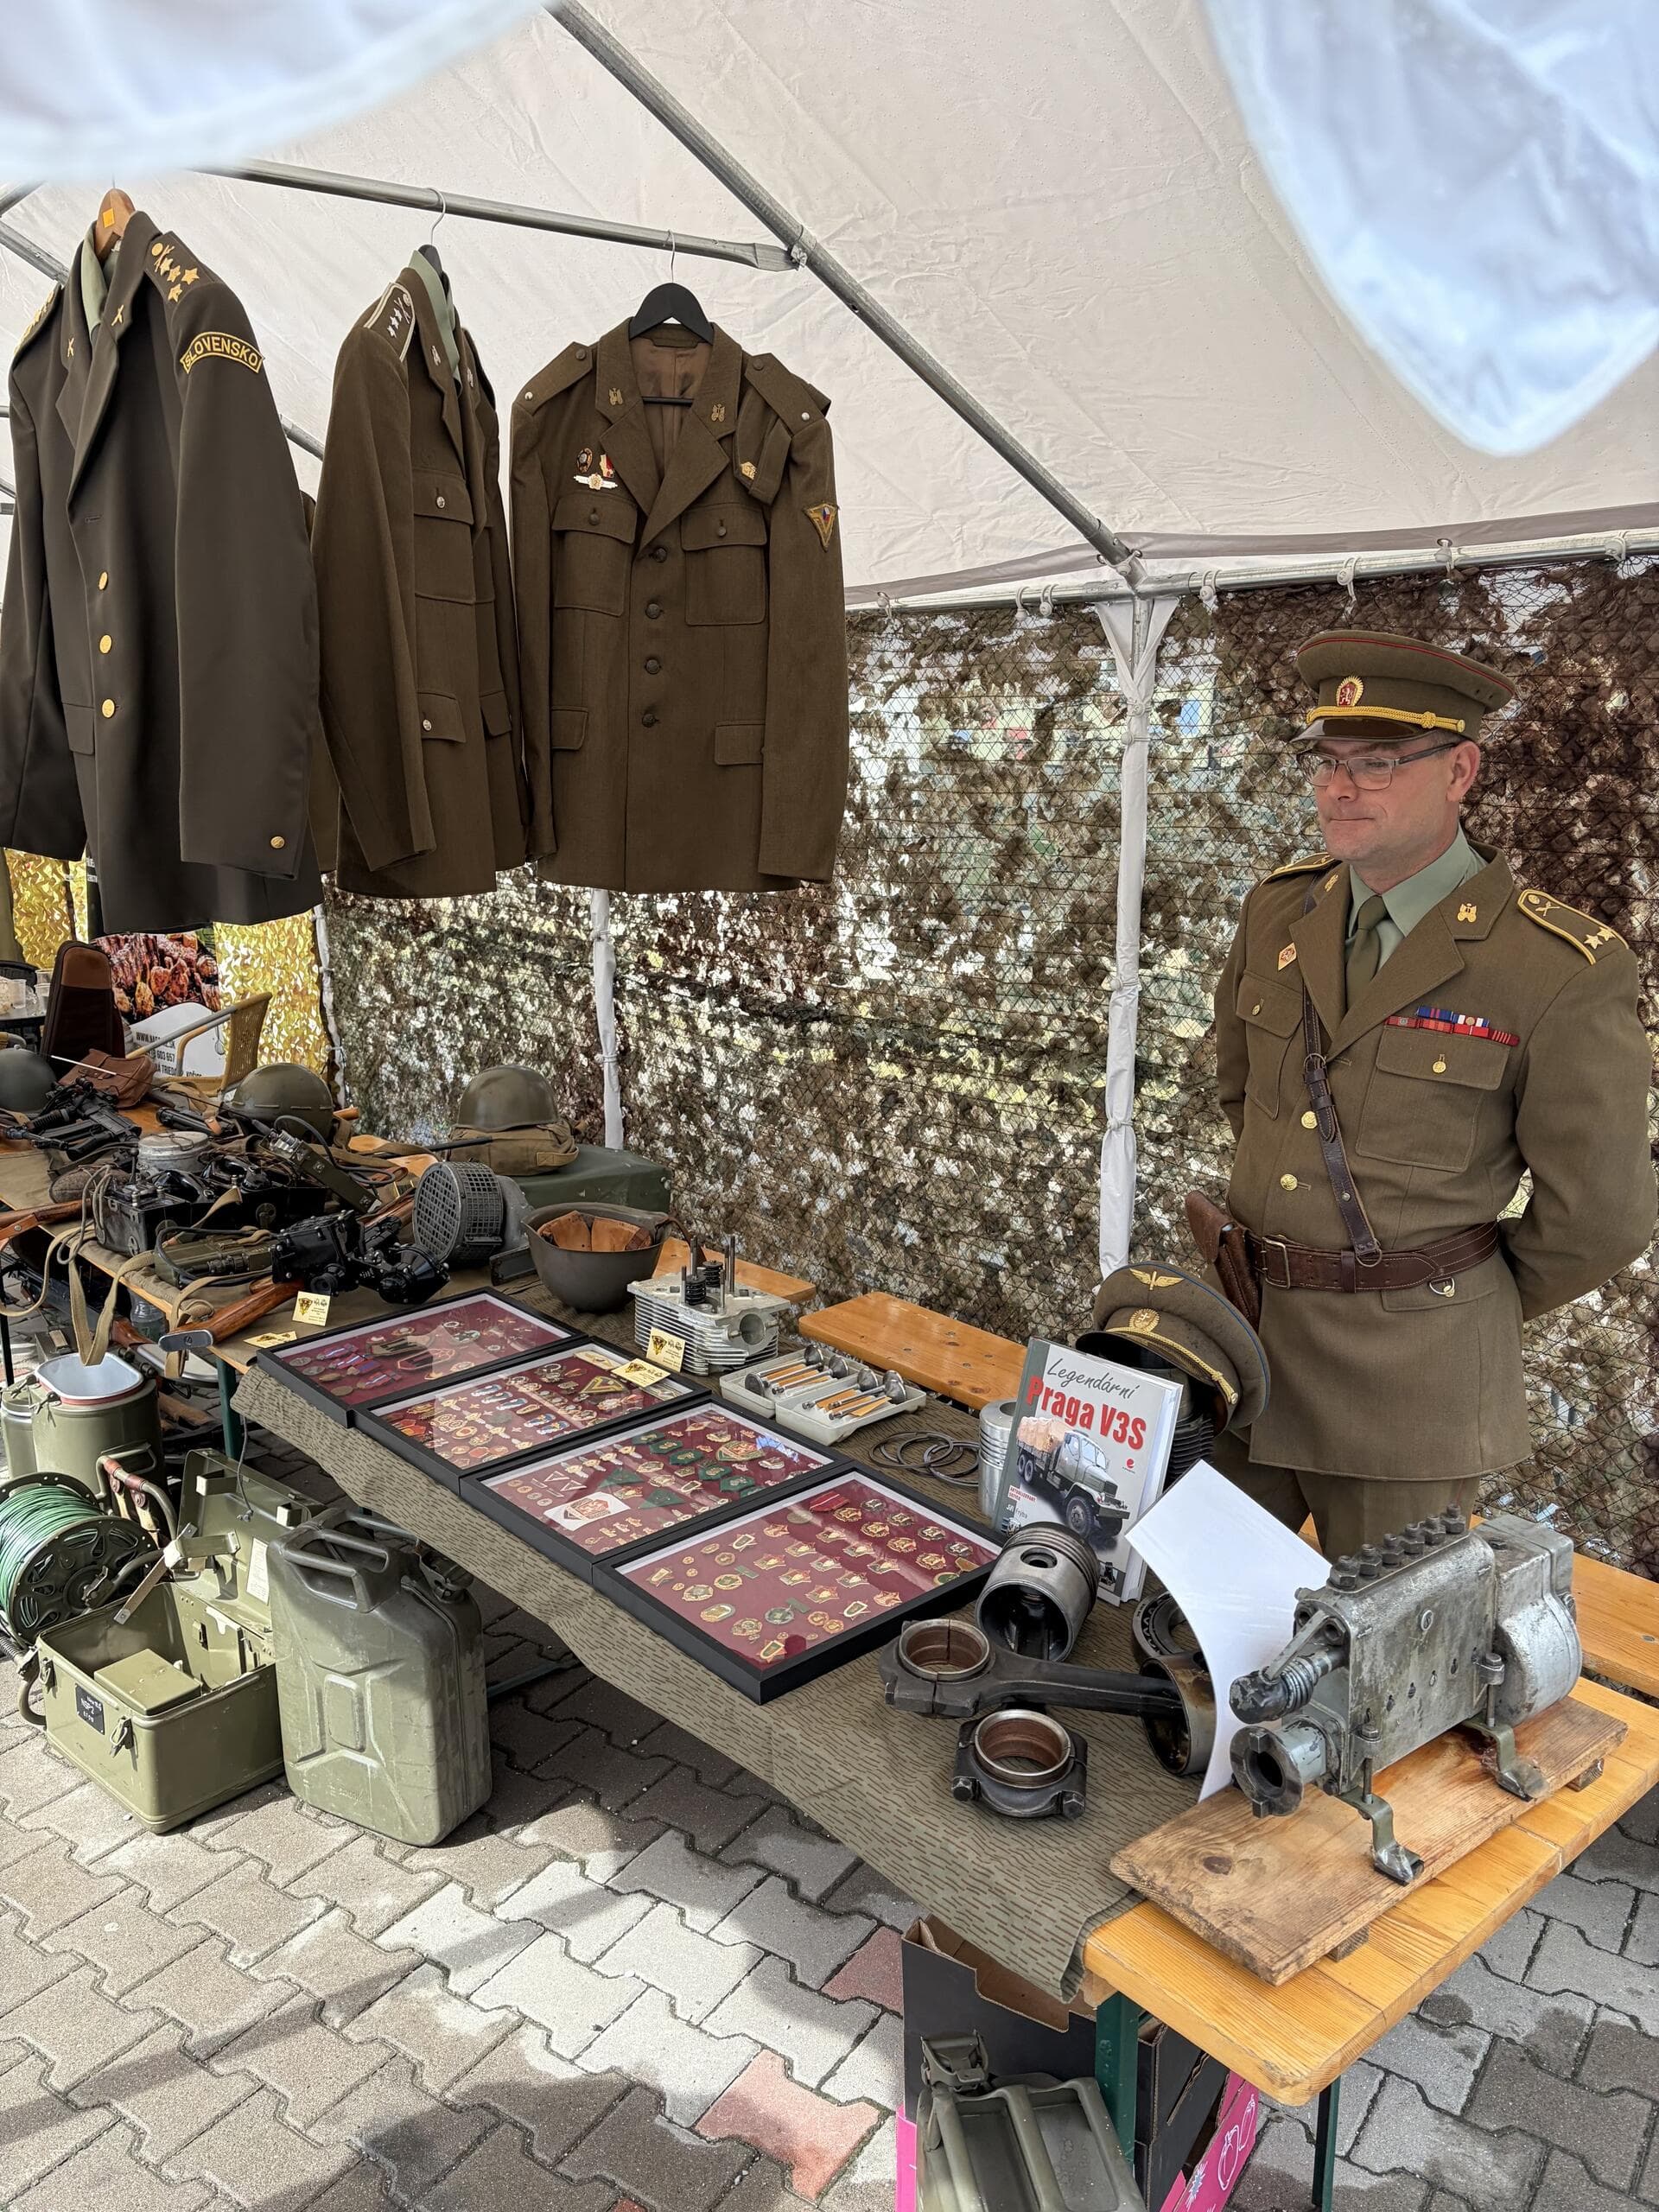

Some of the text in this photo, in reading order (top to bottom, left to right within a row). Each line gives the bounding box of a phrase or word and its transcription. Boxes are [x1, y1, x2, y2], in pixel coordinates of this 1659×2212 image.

[185, 336, 258, 367] SLOVENSKO
[1047, 1358, 1141, 1399] Legendární
[1026, 1375, 1147, 1451] Praga V3S
